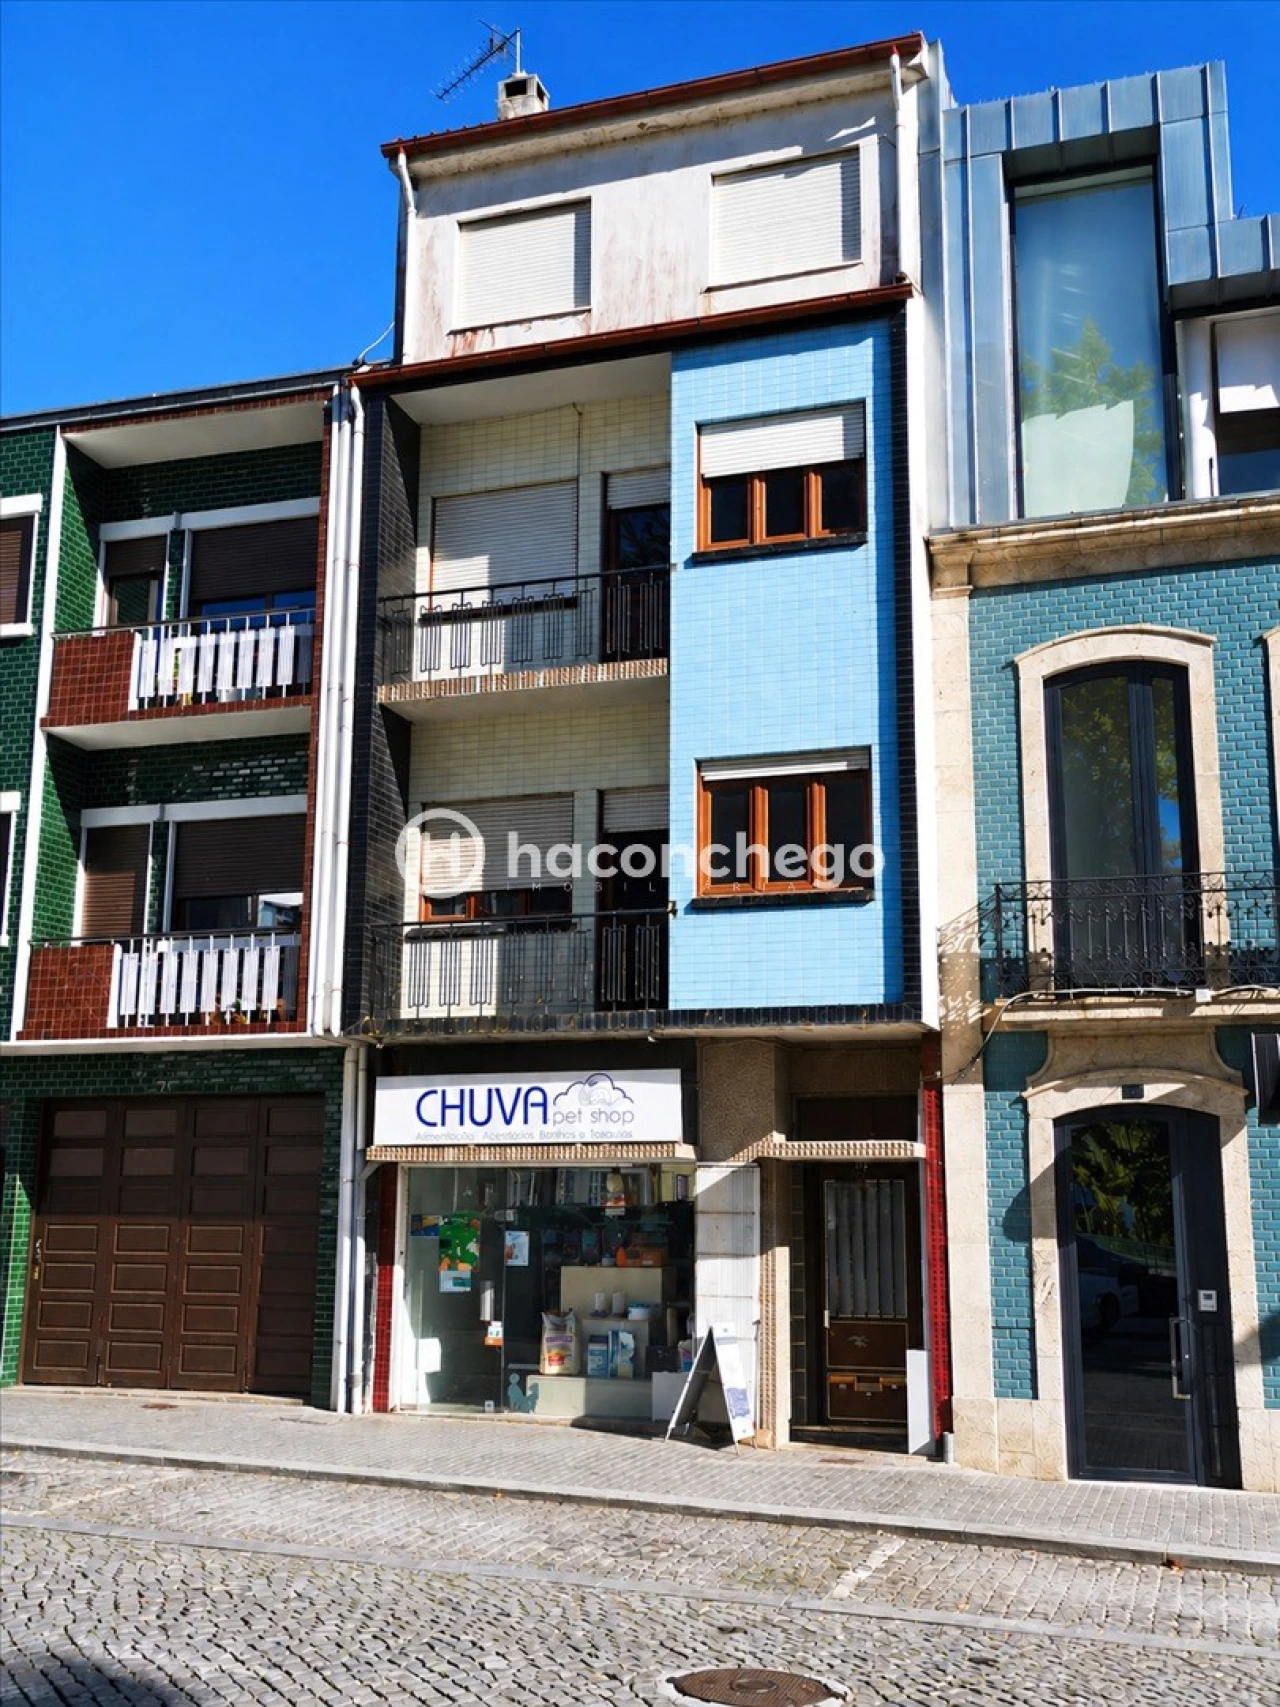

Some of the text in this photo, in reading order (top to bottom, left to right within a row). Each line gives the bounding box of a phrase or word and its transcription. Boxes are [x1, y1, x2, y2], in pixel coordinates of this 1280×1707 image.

[416, 1086, 548, 1127] CHUVA
[553, 1108, 634, 1127] pet shop
